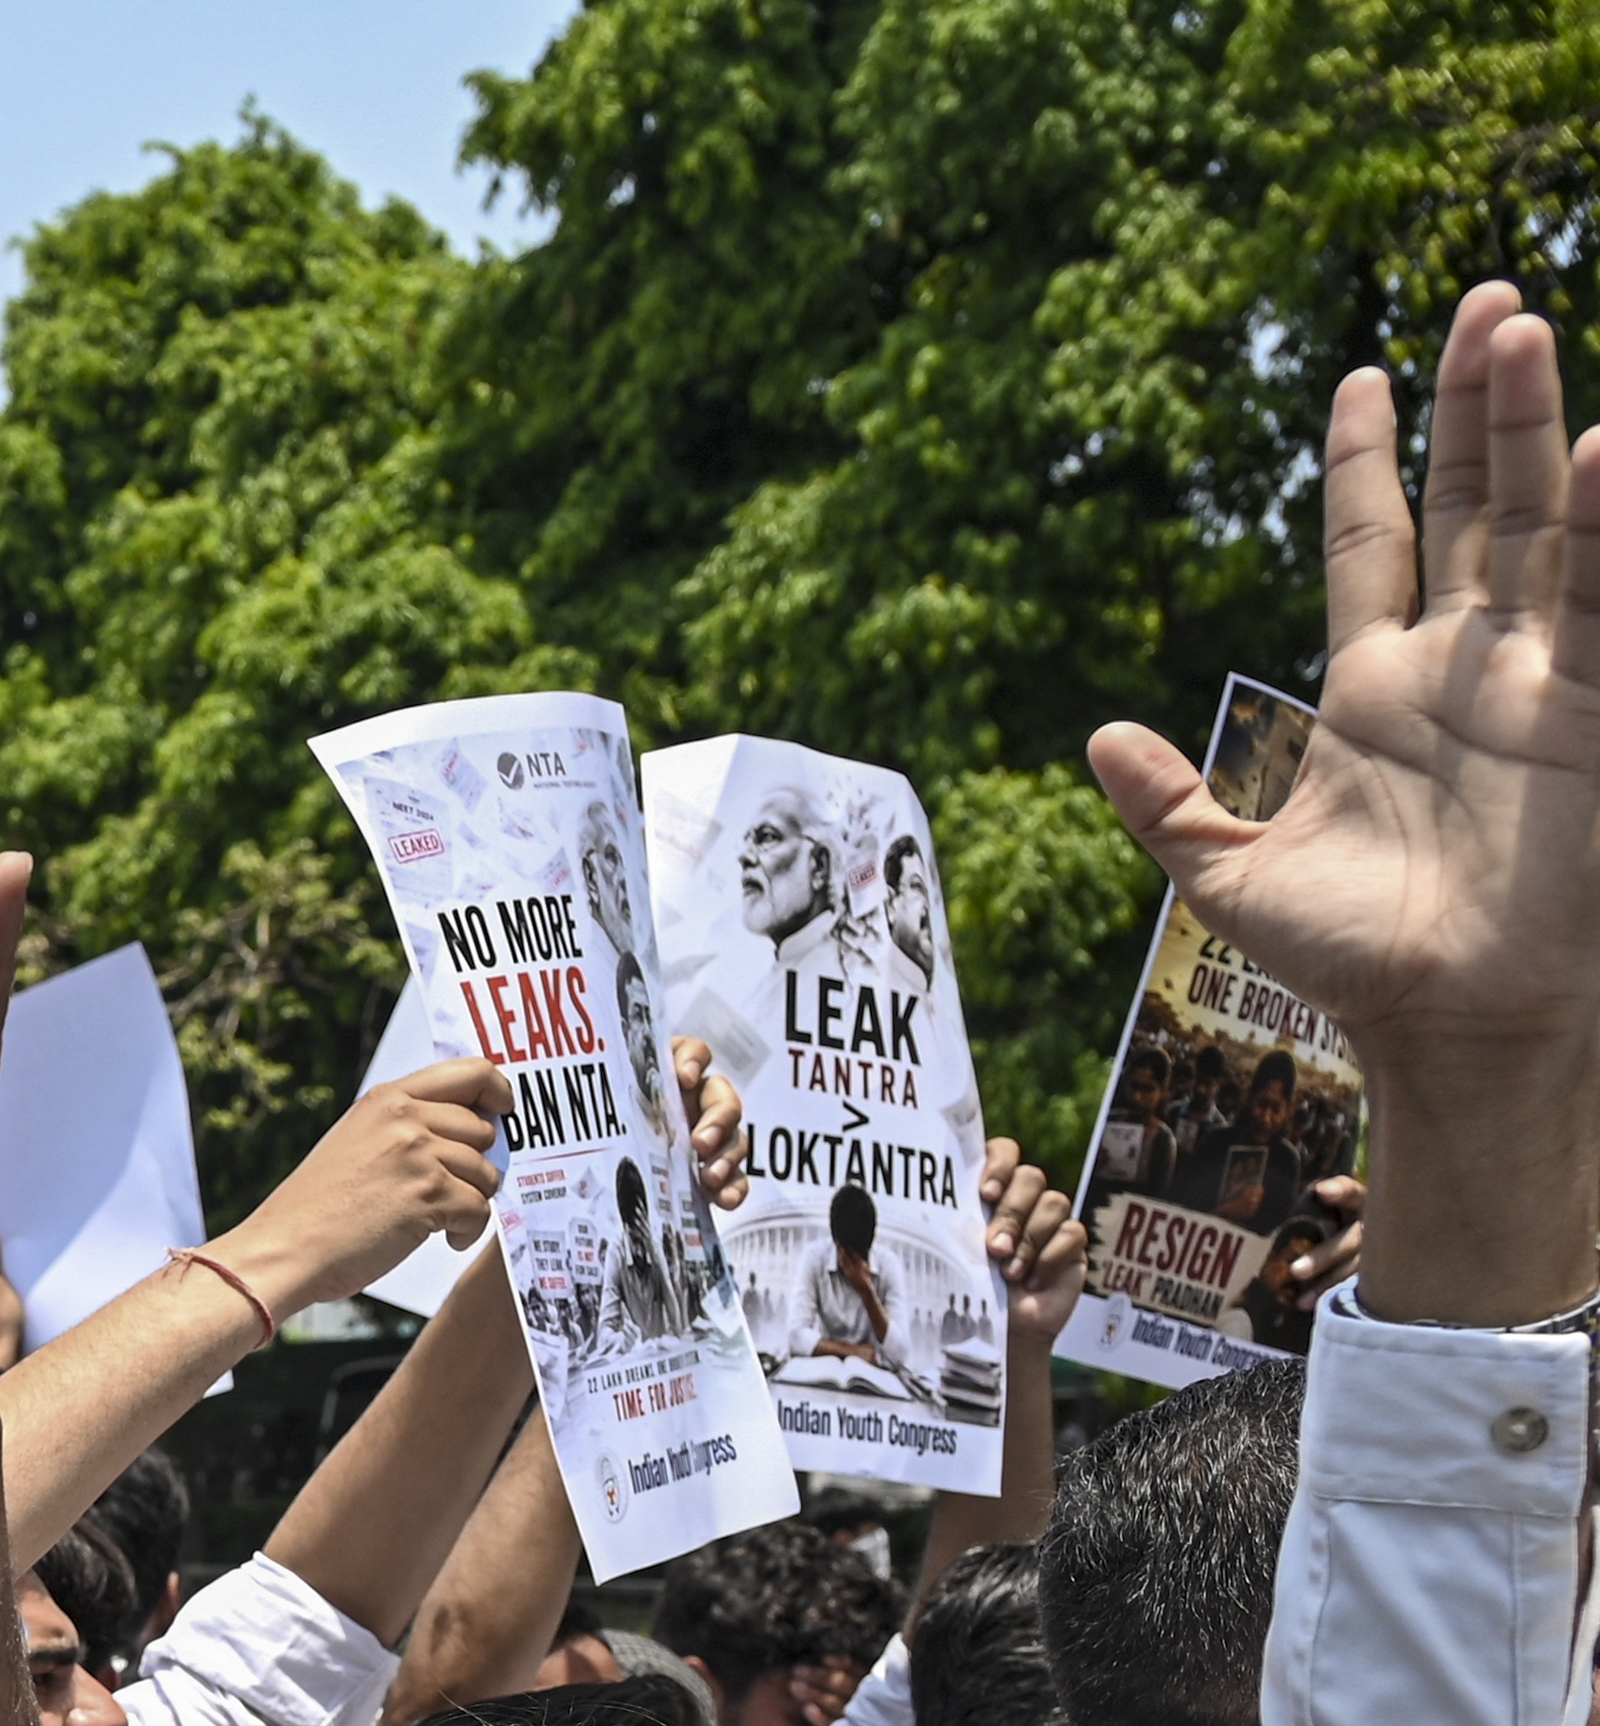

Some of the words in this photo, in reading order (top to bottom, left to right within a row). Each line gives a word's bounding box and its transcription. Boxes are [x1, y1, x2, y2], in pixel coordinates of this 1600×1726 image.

[526, 752, 566, 778] NTA
[394, 835, 439, 858] LEAKED
[437, 906, 497, 972] NO
[497, 895, 583, 965] MORE
[461, 966, 605, 1065] LEAKS.
[784, 970, 921, 1066] LEAK
[1188, 963, 1238, 1015] ONE
[1238, 980, 1317, 1045] BROKEN
[502, 1067, 564, 1153] BAN
[563, 1062, 627, 1142] NTA.
[788, 1048, 920, 1109] TANTRA
[746, 1123, 959, 1209] LOKTANTRA
[1114, 1202, 1244, 1290] RESIGN
[1152, 1277, 1225, 1320] PRADHAN
[1132, 1309, 1174, 1349] Indian
[1174, 1321, 1213, 1361] Youth
[587, 1377, 598, 1394] 22
[601, 1372, 622, 1390] LAKH
[613, 1388, 644, 1422] TIME
[648, 1382, 667, 1413] FOR
[777, 1400, 831, 1437] Indian
[837, 1407, 883, 1443] Youth
[888, 1414, 957, 1458] Congress
[628, 1452, 669, 1494] Indian
